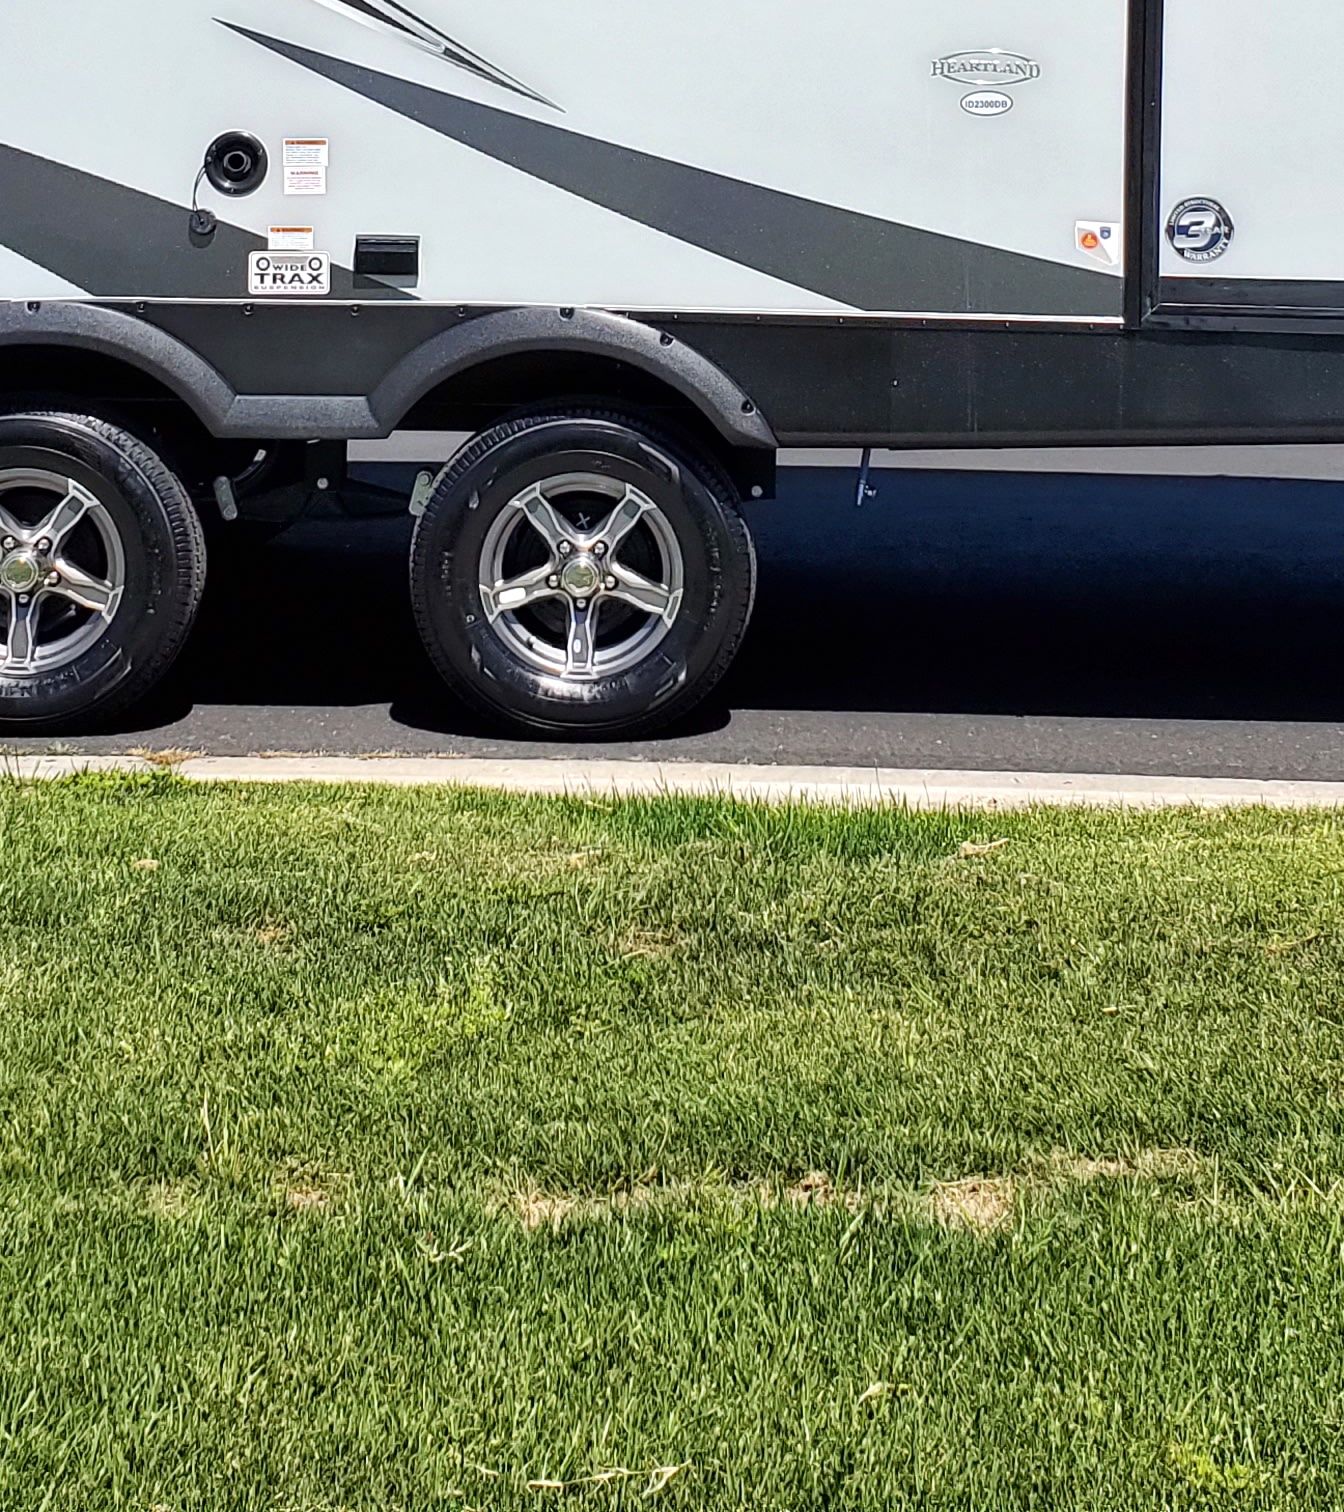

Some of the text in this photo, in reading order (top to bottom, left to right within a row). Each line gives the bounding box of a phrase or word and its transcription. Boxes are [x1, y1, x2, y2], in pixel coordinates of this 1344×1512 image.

[931, 59, 1041, 79] HEARTLAND
[1173, 210, 1216, 249] 3
[1183, 238, 1230, 261] WARRANTY
[272, 264, 307, 272] WIDE
[254, 272, 324, 285] TRAX
